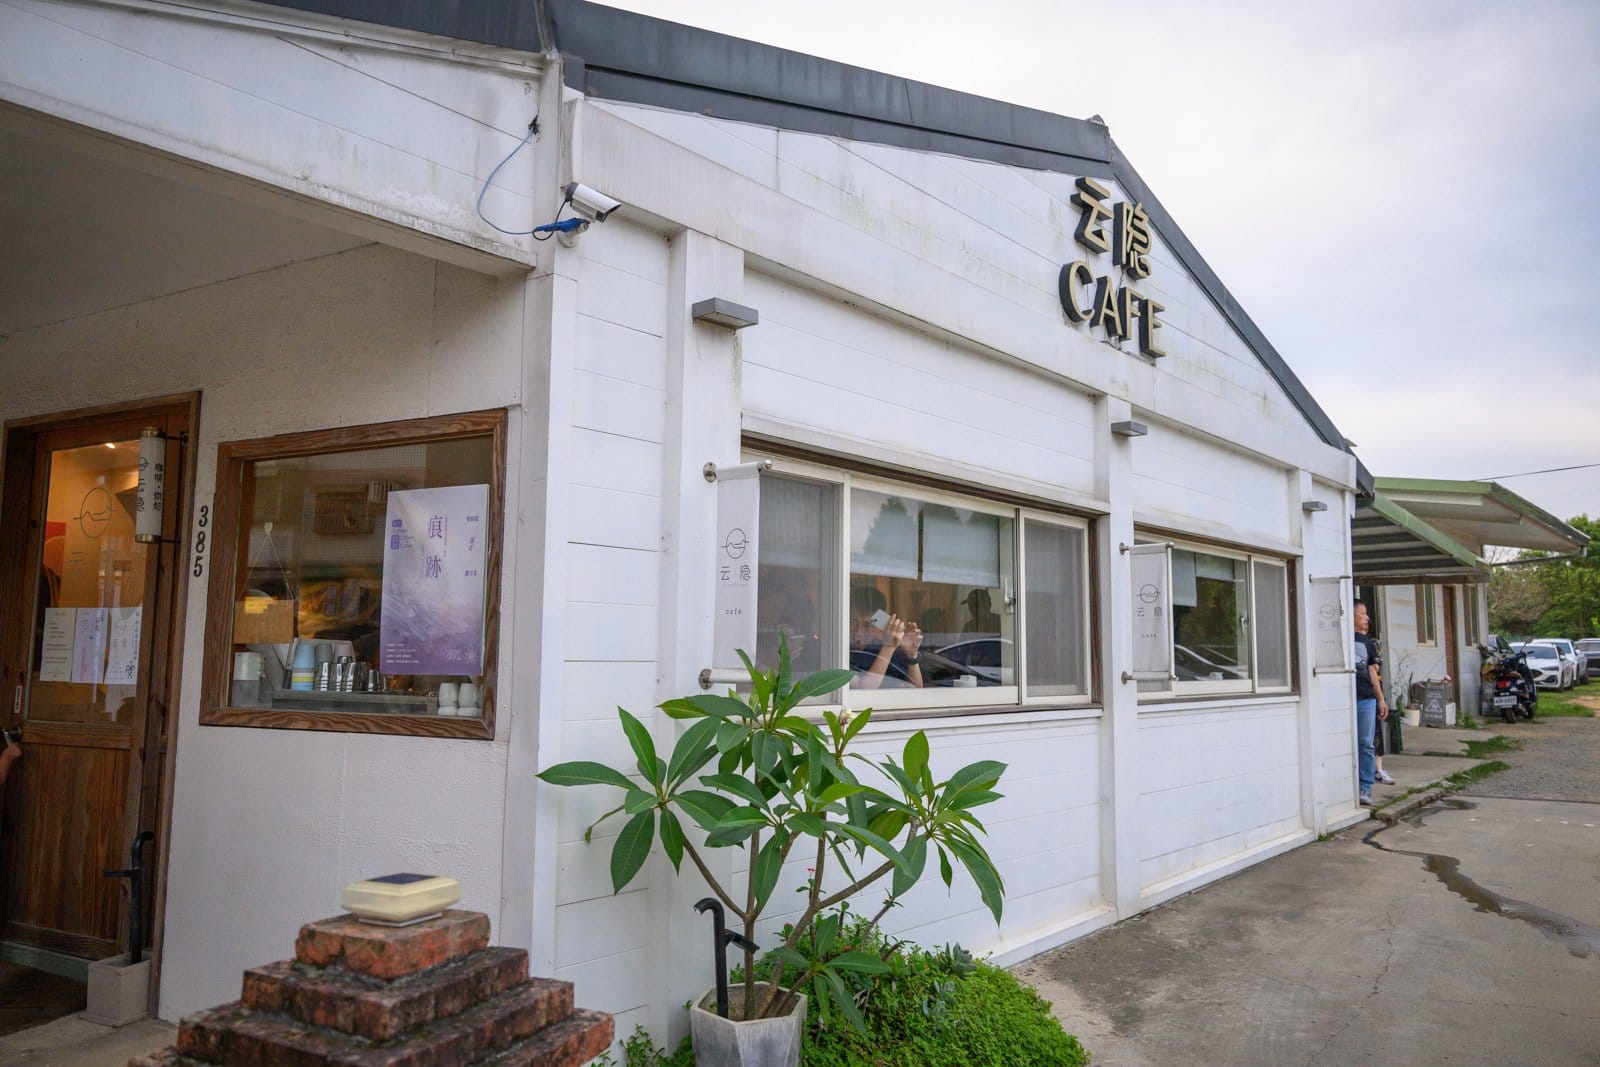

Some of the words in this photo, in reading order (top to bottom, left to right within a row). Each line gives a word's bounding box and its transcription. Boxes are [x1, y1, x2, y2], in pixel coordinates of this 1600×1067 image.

[1059, 260, 1166, 358] CAFE
[194, 505, 208, 577] 385
[425, 515, 443, 579] 痕跡
